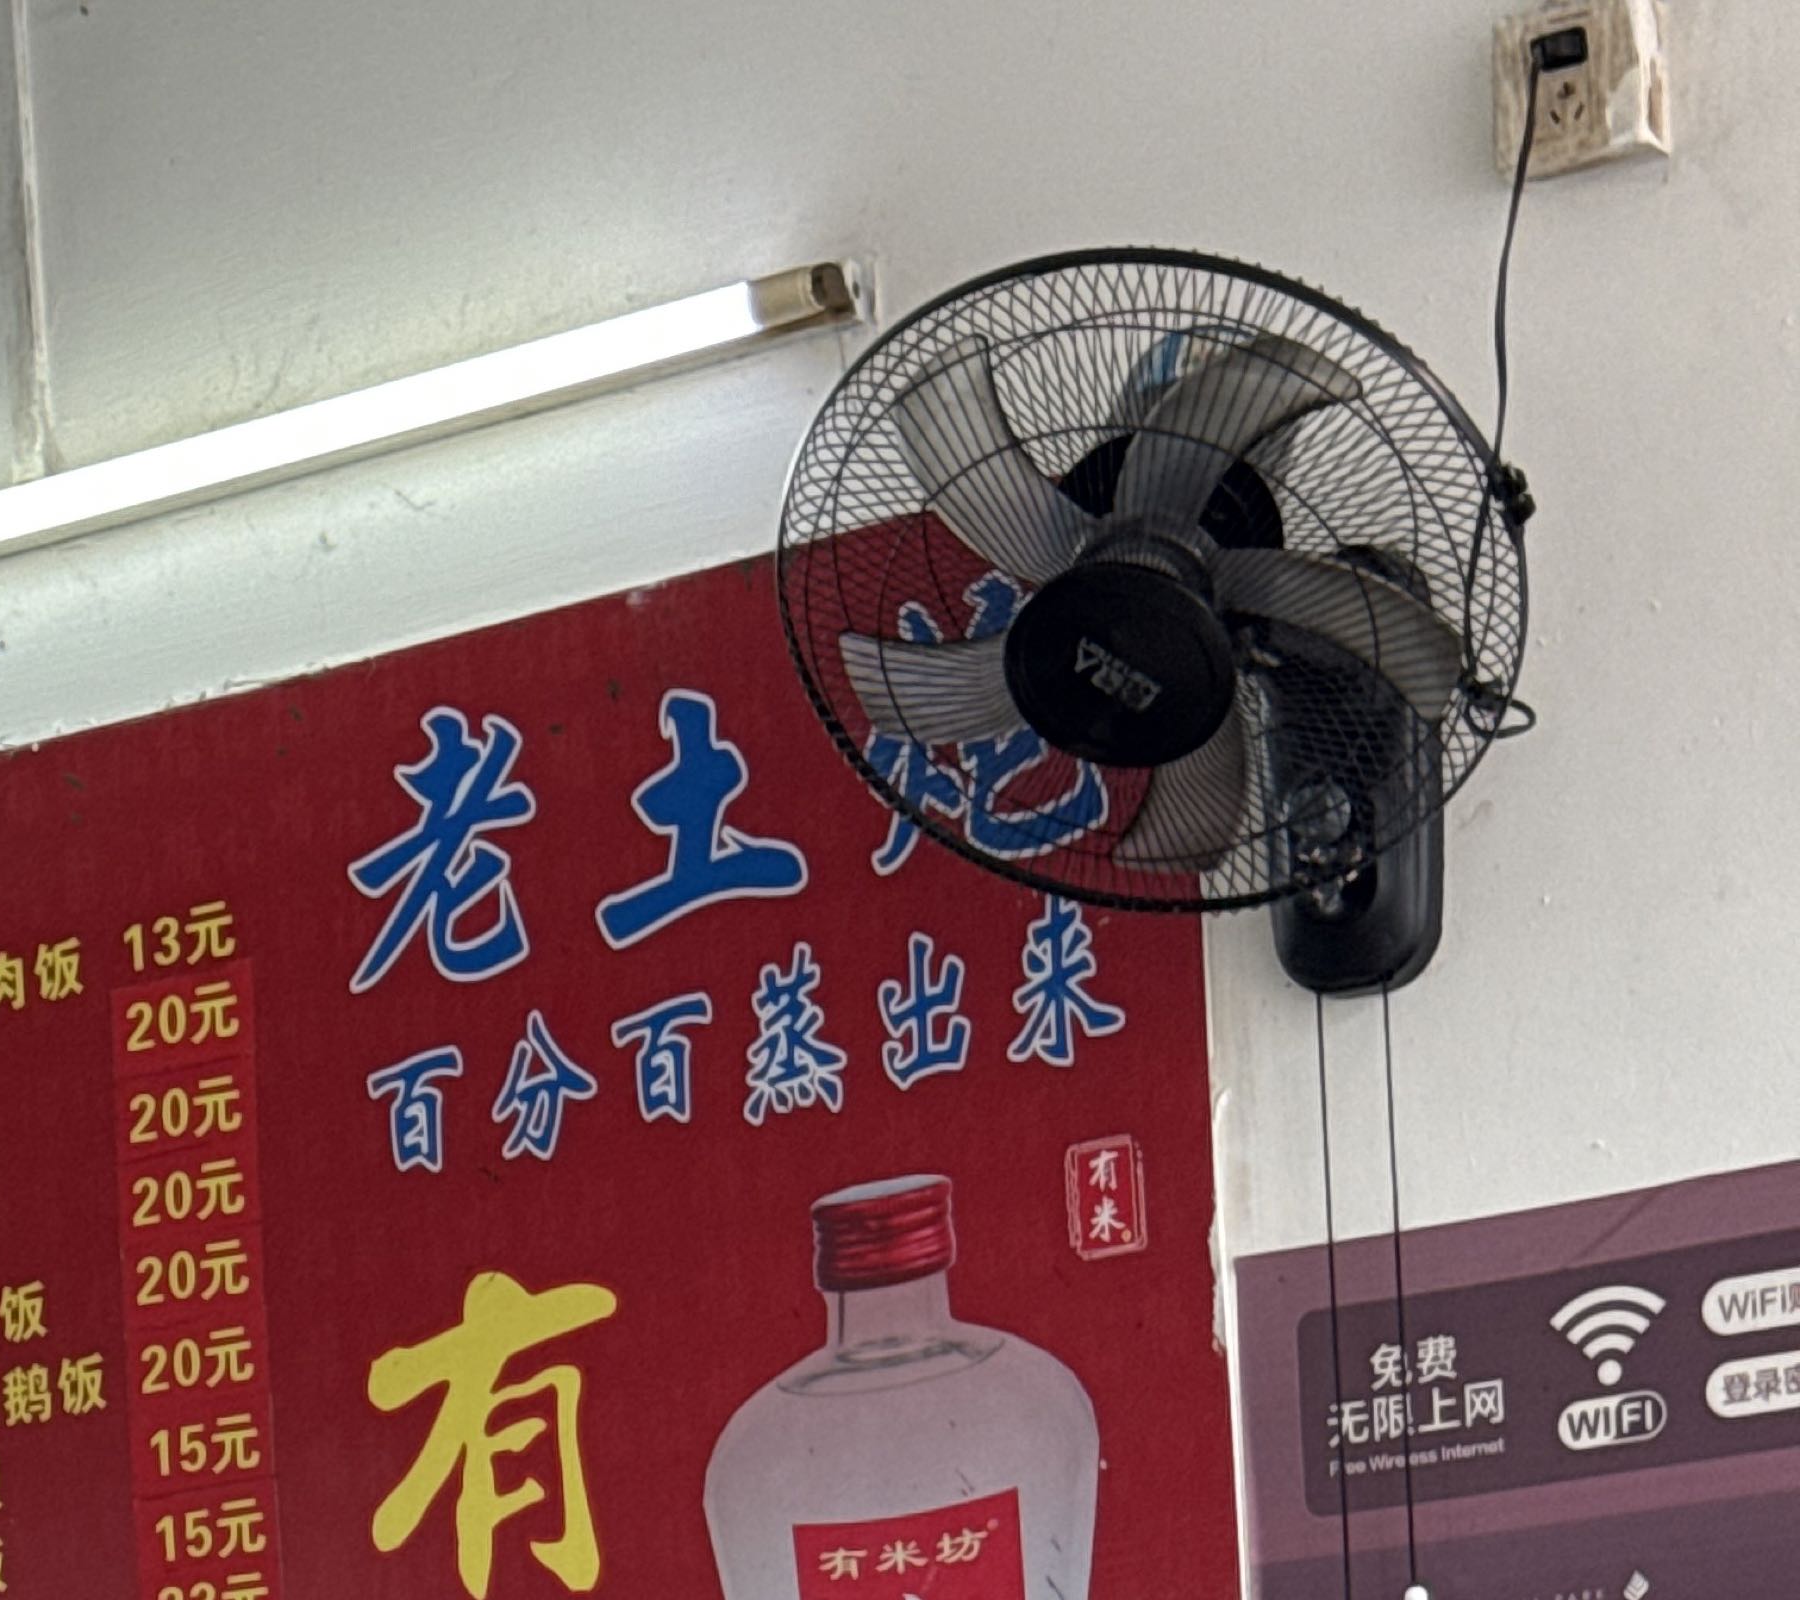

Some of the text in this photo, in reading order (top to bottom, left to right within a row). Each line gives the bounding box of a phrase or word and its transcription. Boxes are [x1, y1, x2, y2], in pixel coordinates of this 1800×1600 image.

[123, 901, 236, 971] 13元
[126, 981, 239, 1052] 20元
[366, 898, 1125, 1173] 百分百蒸出来
[129, 1075, 243, 1144] 20元
[132, 1158, 245, 1227] 20元
[1089, 1148, 1126, 1243] 有米
[136, 1239, 249, 1306] 20元
[141, 1326, 254, 1394] 20元
[1369, 1333, 1458, 1392] 免费
[150, 1413, 260, 1476] 15元
[1326, 1378, 1506, 1448] 无限上网
[1566, 1399, 1654, 1442] WIFI
[1329, 1458, 1367, 1478] Fee
[1369, 1450, 1439, 1473] Wireess
[155, 1498, 267, 1562] 15元
[818, 1527, 988, 1581] 有米坊
